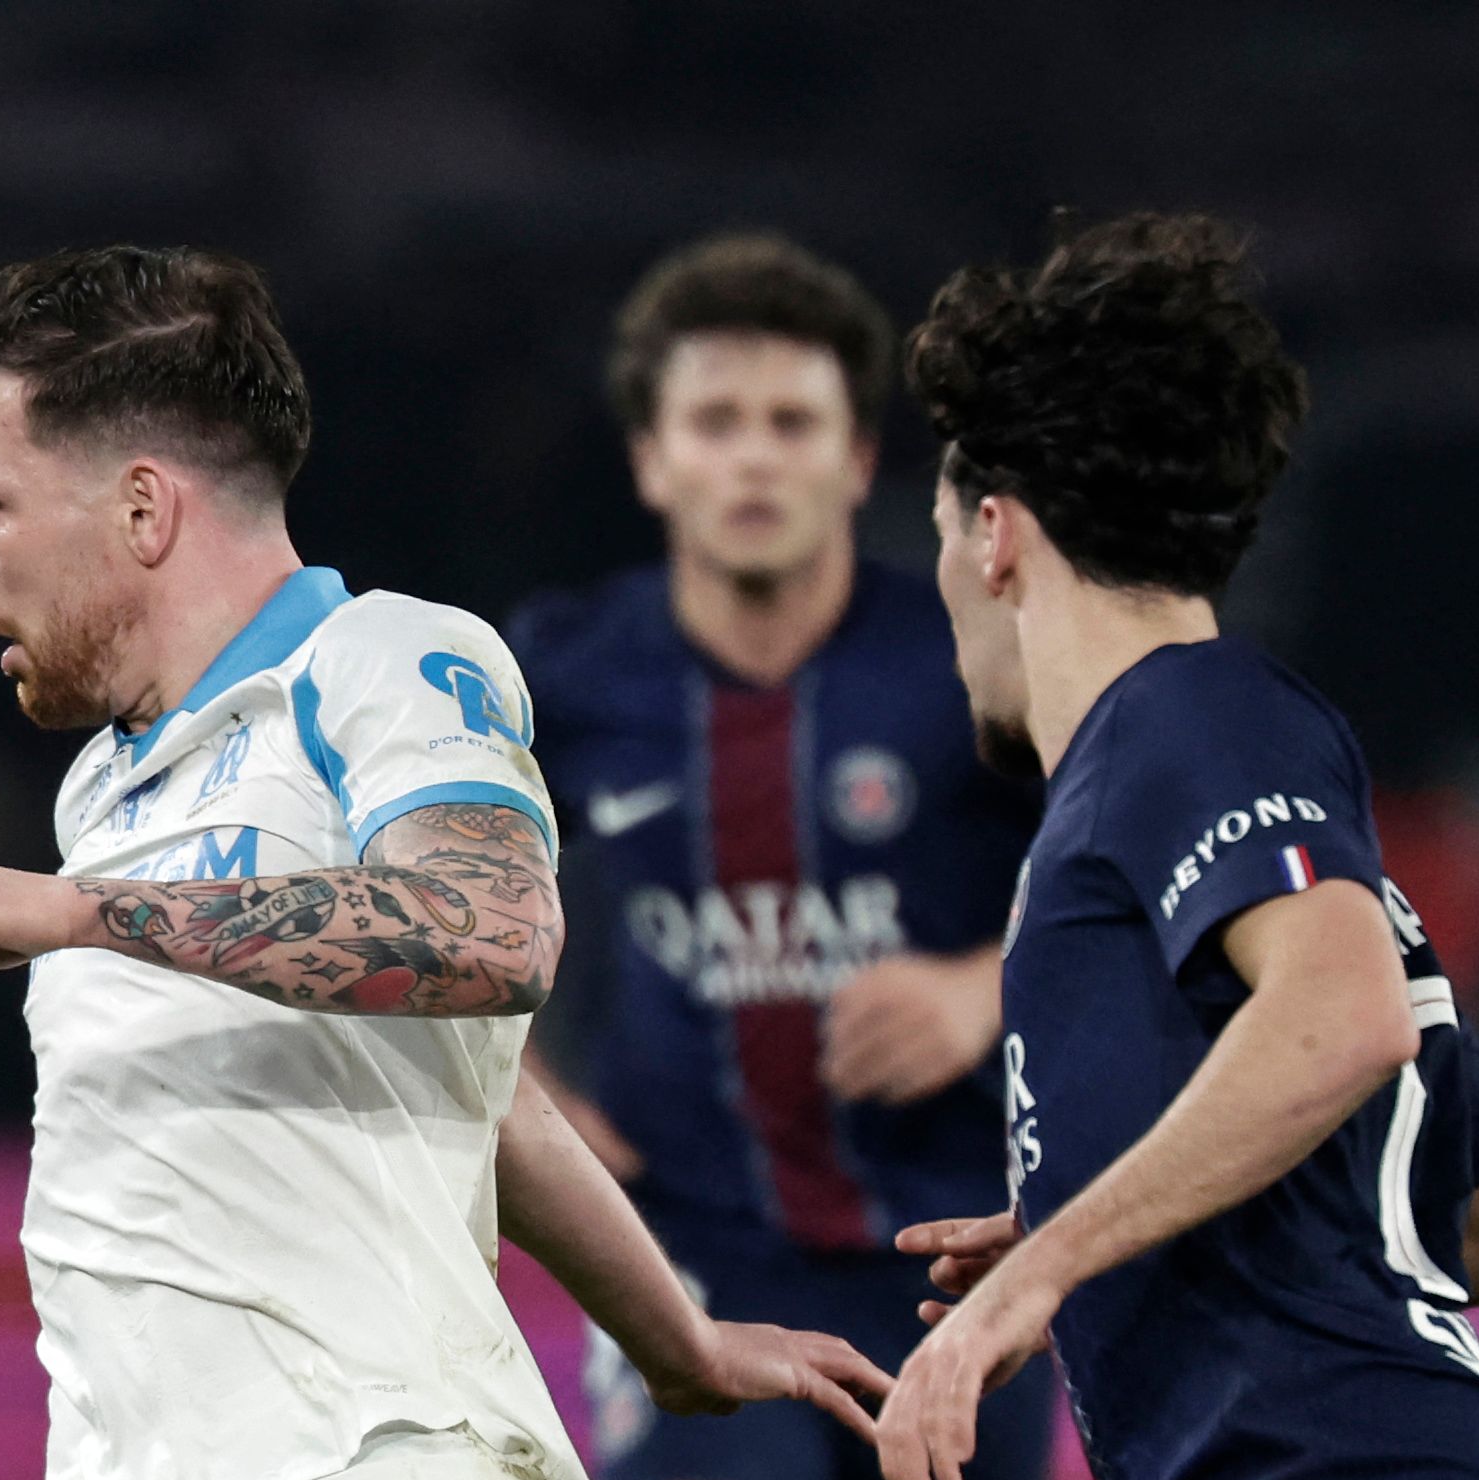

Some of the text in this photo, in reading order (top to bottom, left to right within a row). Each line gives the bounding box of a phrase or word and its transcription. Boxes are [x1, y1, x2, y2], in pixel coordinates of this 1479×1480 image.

[428, 735, 463, 750] D'OR
[1159, 792, 1328, 921] BEYOND
[624, 874, 906, 978] QATAR
